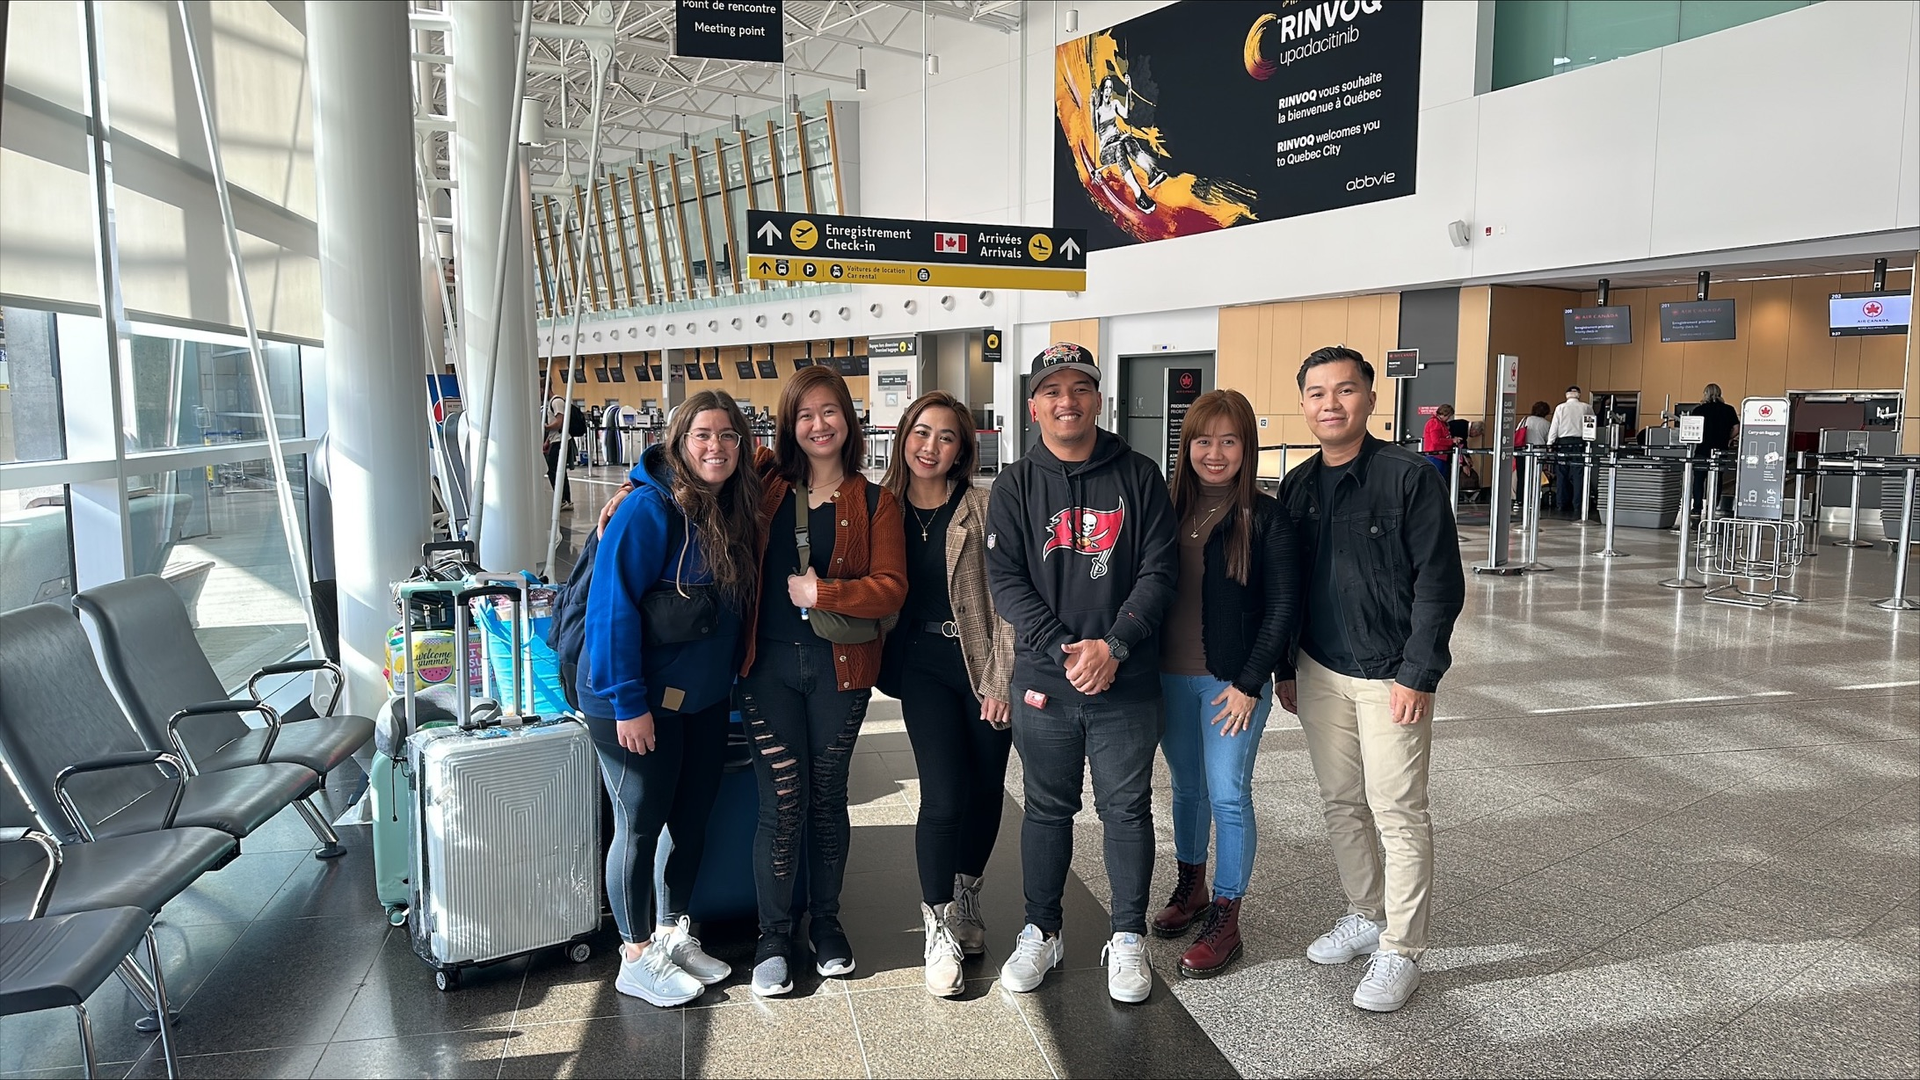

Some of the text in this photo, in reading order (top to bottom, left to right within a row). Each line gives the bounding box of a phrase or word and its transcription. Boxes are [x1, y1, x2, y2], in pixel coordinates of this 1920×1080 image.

[682, 0, 776, 14] Point de rencontre
[694, 21, 765, 37] Meeting point
[1281, 0, 1383, 44] RINVOQ
[1280, 24, 1360, 67] upadacitinib
[1278, 72, 1383, 110] RINVOQ vous souhaite
[1278, 88, 1382, 124] la bienvenue à Québec
[1277, 119, 1380, 153] RINVOQ welcomes you
[1276, 143, 1341, 167] to Quebec City
[1346, 171, 1396, 191] abbvie
[825, 223, 912, 240] Enregistrement
[978, 232, 1022, 245] Arrivées
[825, 238, 876, 252] Check-in
[980, 246, 1022, 259] Arrivals
[847, 265, 872, 273] Voitures
[414, 648, 452, 661] welcome
[417, 658, 450, 667] summer
[469, 659, 482, 668] SU
